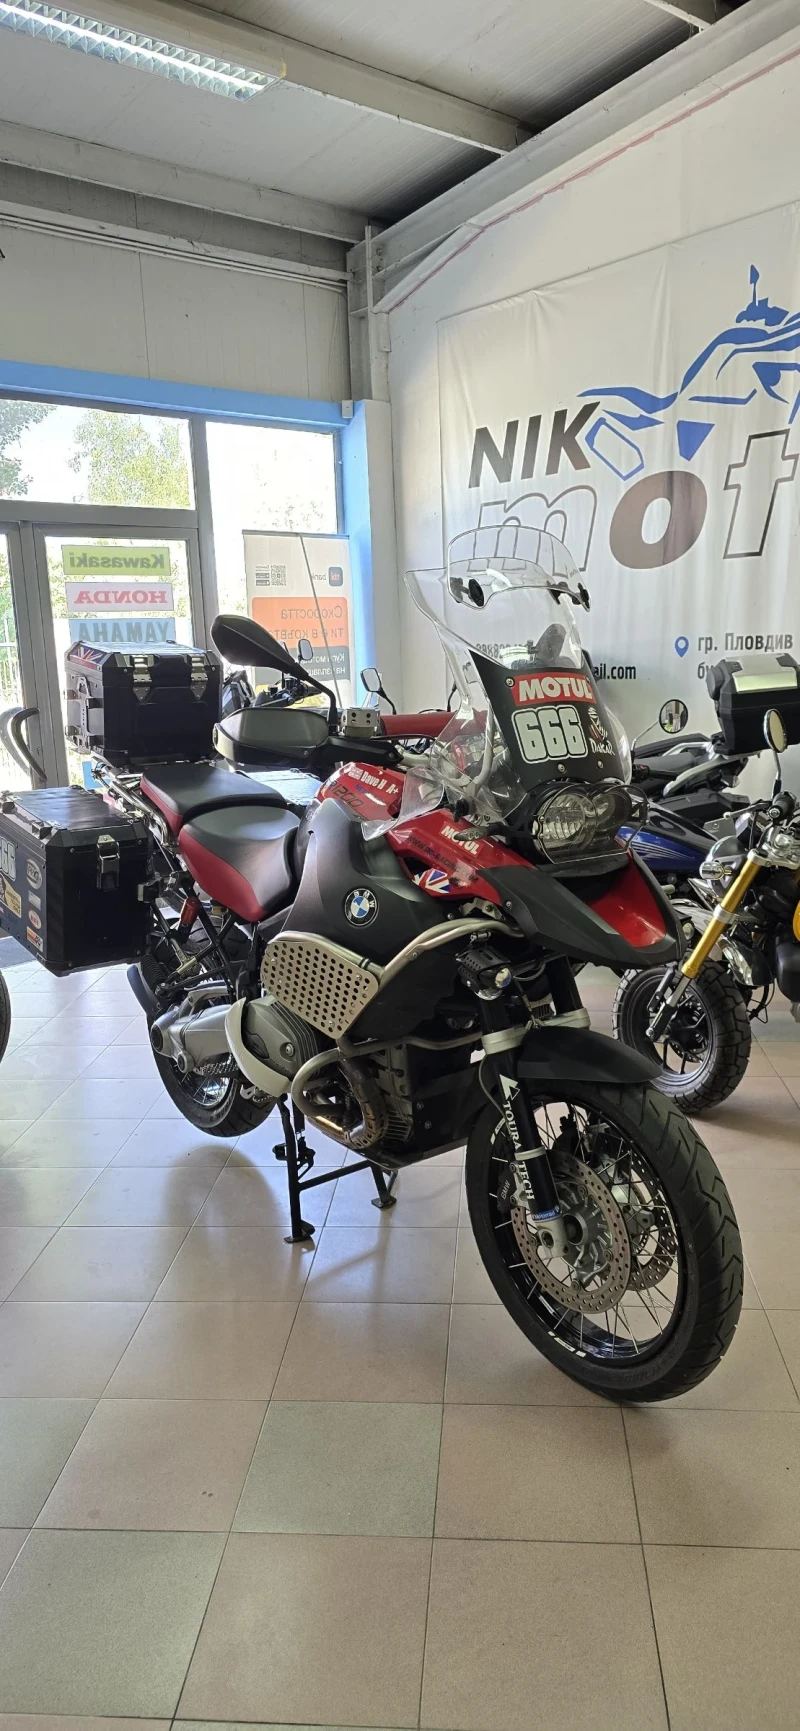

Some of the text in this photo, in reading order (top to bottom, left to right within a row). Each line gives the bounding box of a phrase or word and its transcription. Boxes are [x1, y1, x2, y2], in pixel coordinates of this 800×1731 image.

[468, 402, 600, 489] NIK
[697, 632, 794, 654] гр. Пловдив
[519, 677, 594, 702] MOTUL
[512, 705, 589, 764] 666
[353, 890, 376, 908] BMW
[518, 1160, 535, 1200] TECH
